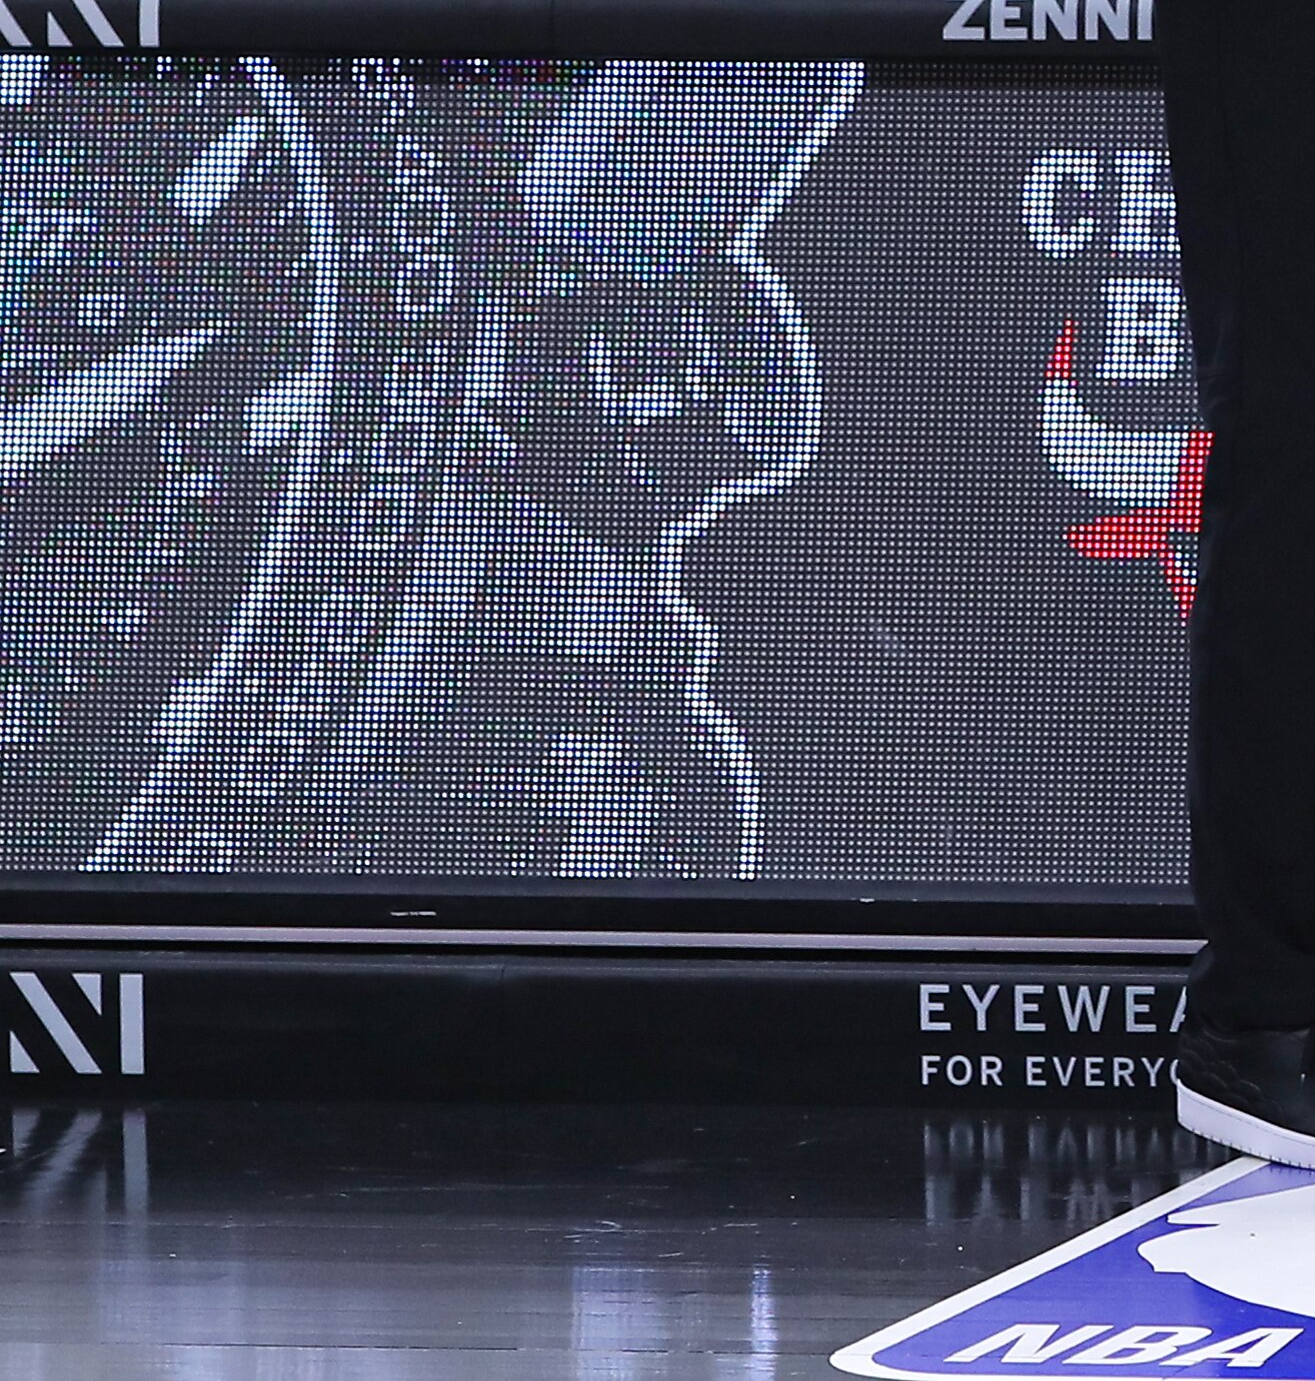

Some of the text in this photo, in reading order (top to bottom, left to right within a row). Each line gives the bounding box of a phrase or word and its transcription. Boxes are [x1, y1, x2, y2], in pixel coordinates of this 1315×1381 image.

[921, 1055, 1179, 1087] FOR EVERY
[943, 1323, 1305, 1368] NBA
